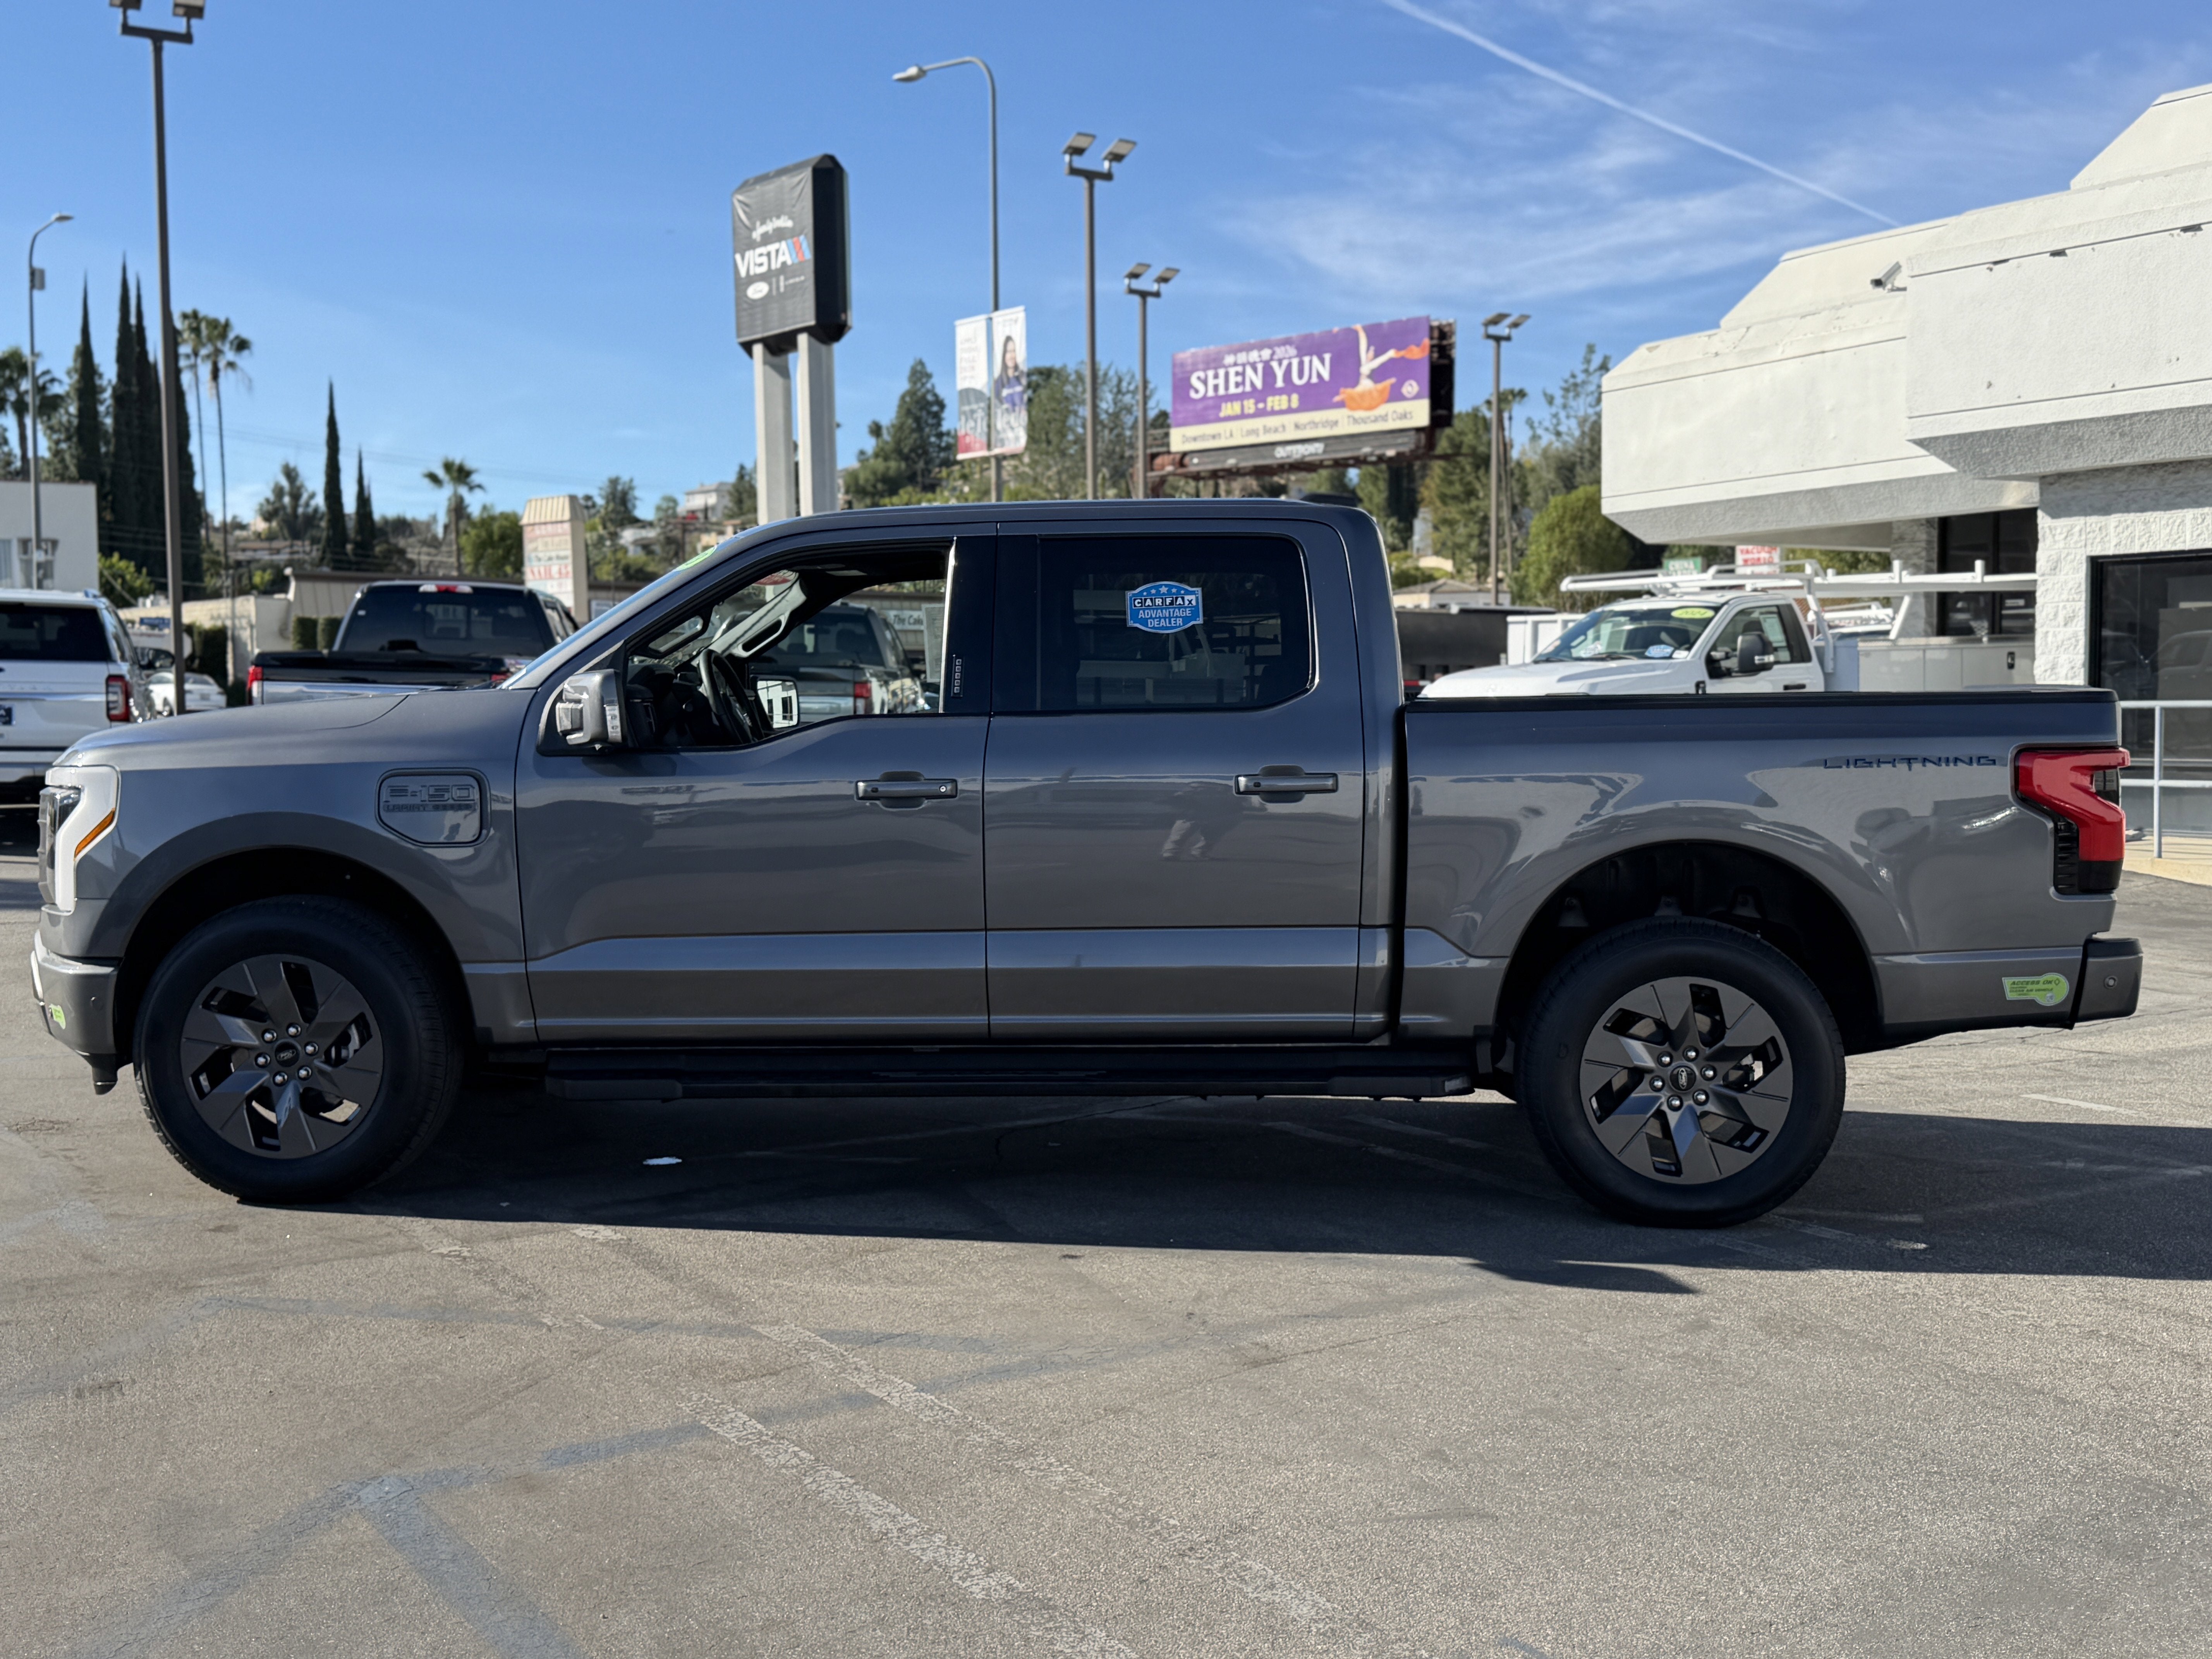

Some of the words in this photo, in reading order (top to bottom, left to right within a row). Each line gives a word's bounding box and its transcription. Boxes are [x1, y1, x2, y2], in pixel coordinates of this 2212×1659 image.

[735, 240, 792, 278] VISTA
[1189, 362, 1264, 400] SHEN
[1269, 353, 1332, 388] YUN
[1219, 401, 1242, 417] JAN
[1243, 399, 1255, 414] 15
[1266, 395, 1290, 411] FEB
[1290, 393, 1299, 409] 8
[1182, 432, 1221, 444] Downtown
[1224, 429, 1233, 440] LA
[1240, 427, 1260, 438] Long
[1262, 424, 1286, 434] Beach
[1294, 418, 1338, 431] Northridge
[1347, 411, 1389, 426] Thousand
[1391, 410, 1413, 421] Oaks
[1134, 597, 1194, 608] CARFAX
[893, 614, 906, 625] The
[907, 614, 924, 625] Cak
[1138, 608, 1192, 619] ADVANTAGE
[1147, 618, 1183, 627] DEALER
[1824, 756, 1996, 771] LIGHTNING
[383, 784, 475, 802] F-150
